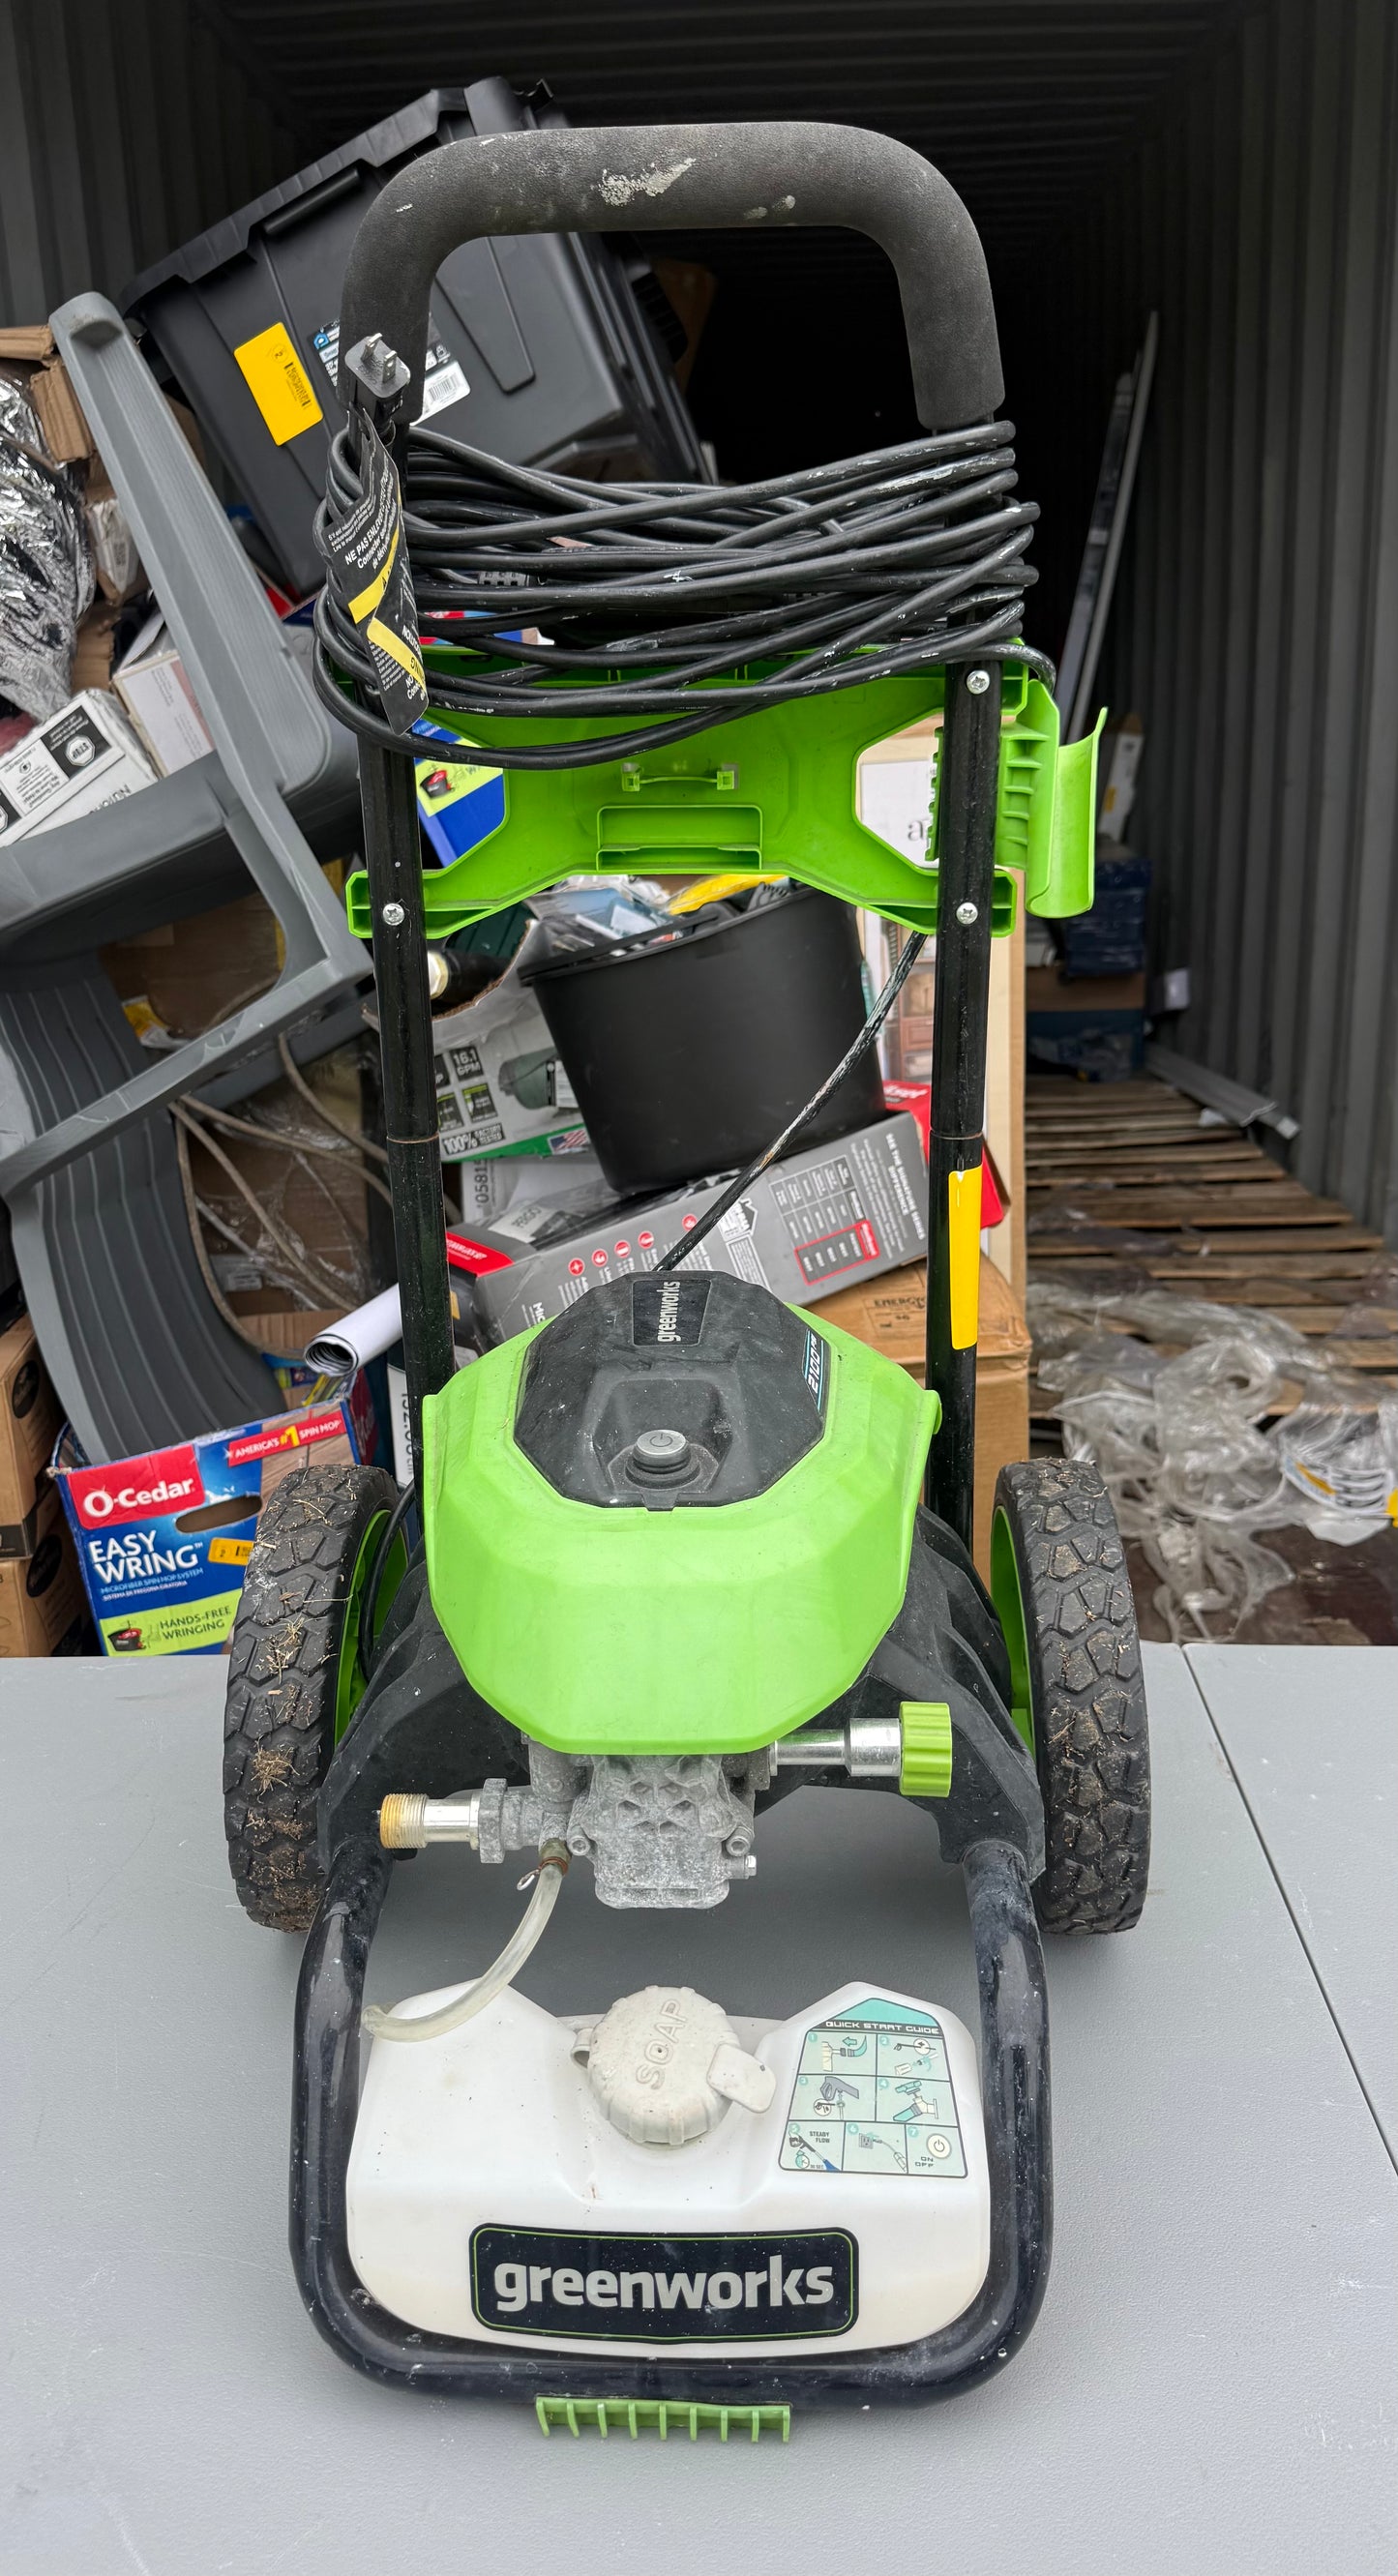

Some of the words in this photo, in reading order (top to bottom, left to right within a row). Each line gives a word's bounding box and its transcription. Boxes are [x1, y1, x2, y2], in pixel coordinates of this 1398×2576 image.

[344, 549, 358, 566] NE
[356, 537, 369, 554] PAS
[442, 1130, 478, 1155] 100%
[657, 1281, 681, 1343] greenworks
[808, 1347, 820, 1394] 2100
[234, 1438, 280, 1458] AMERICA'S
[280, 1425, 300, 1447] #1
[299, 1427, 319, 1439] SPIN
[83, 1478, 194, 1518] O-Cedar
[89, 1530, 157, 1563] EASY
[163, 1619, 224, 1640] WRINGING
[635, 1998, 687, 2090] SOAP
[825, 2021, 860, 2029] QUICK
[863, 2023, 902, 2031] START
[906, 2026, 939, 2034] GUIDE
[494, 2255, 834, 2312] greenworks
